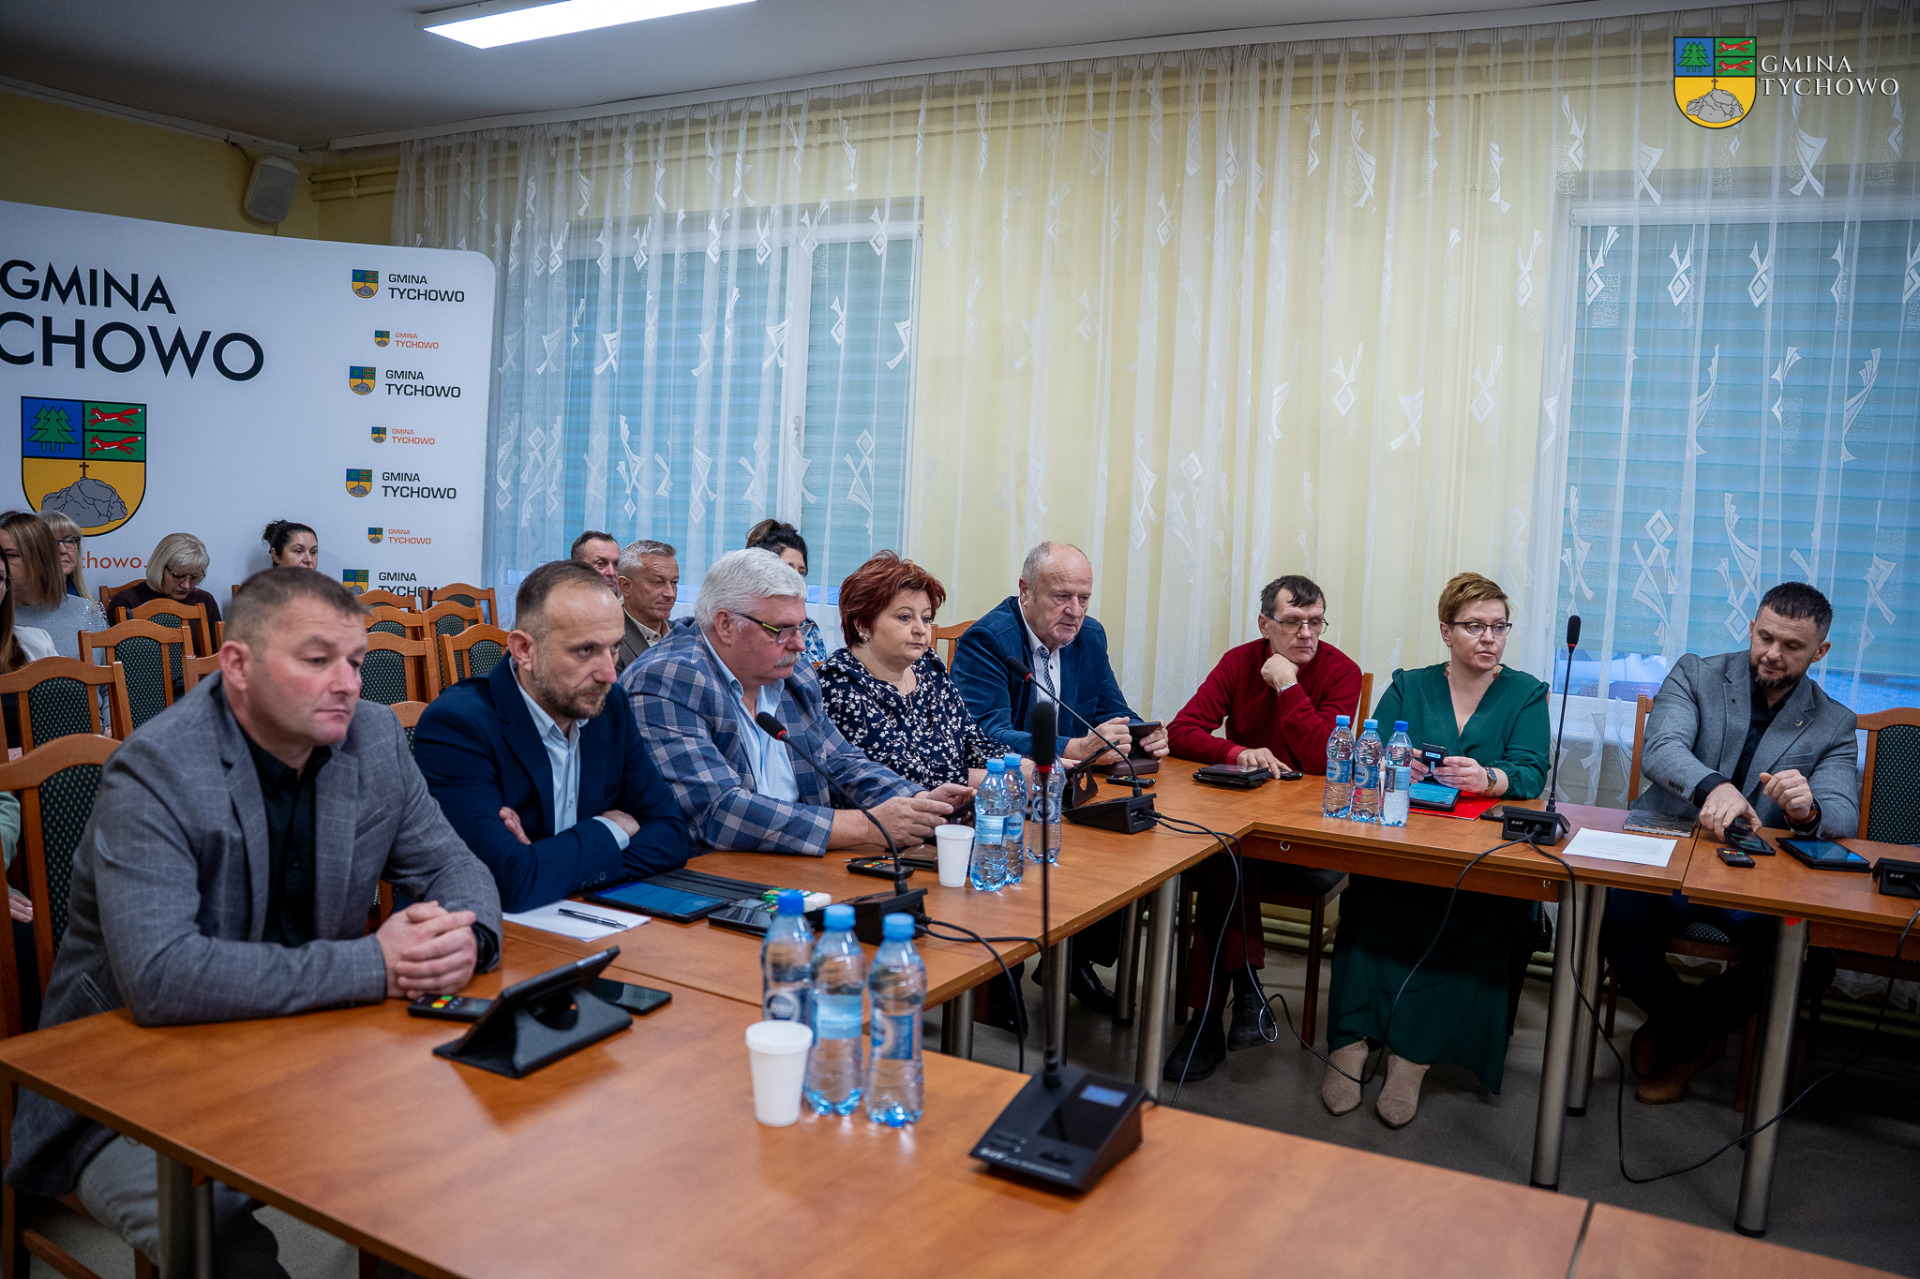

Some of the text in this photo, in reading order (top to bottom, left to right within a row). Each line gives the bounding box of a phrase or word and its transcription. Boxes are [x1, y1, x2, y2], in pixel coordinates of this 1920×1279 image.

[388, 273, 428, 284] GMINA
[0, 259, 177, 315] GMINA
[388, 287, 465, 302] TYCHOWO
[0, 311, 264, 381] CHOWO
[395, 340, 439, 349] TYCHOWO
[385, 369, 425, 380] GMINA
[385, 383, 461, 398] TYCHOWO
[391, 436, 436, 445] TYCHOWO
[382, 472, 420, 482] GMINA
[382, 485, 457, 499] TYCHOWO
[388, 536, 432, 545] TYCHOWO
[81, 551, 148, 569] howo.
[378, 571, 417, 582] GMINA
